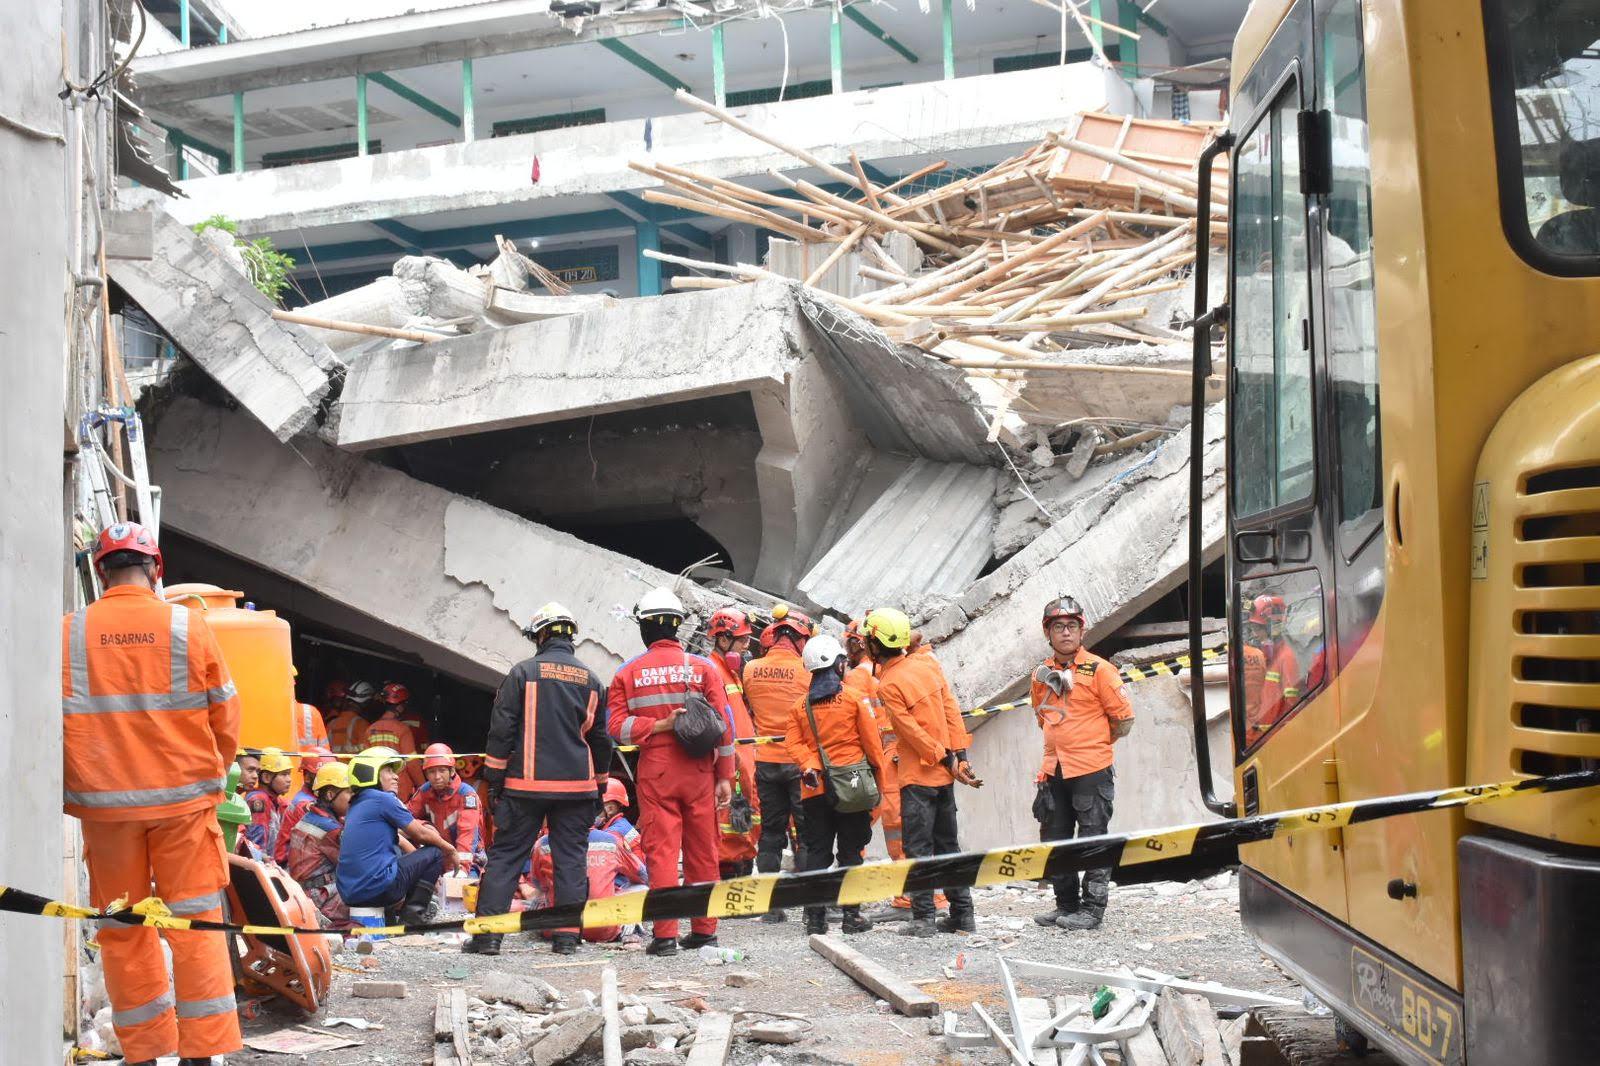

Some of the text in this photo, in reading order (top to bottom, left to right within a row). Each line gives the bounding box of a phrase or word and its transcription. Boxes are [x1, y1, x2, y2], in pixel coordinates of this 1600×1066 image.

[100, 632, 156, 646] BASARNAS
[634, 673, 703, 688] KOTA BATU
[753, 667, 795, 680] BASARNAS
[1402, 985, 1453, 1059] 80-7
